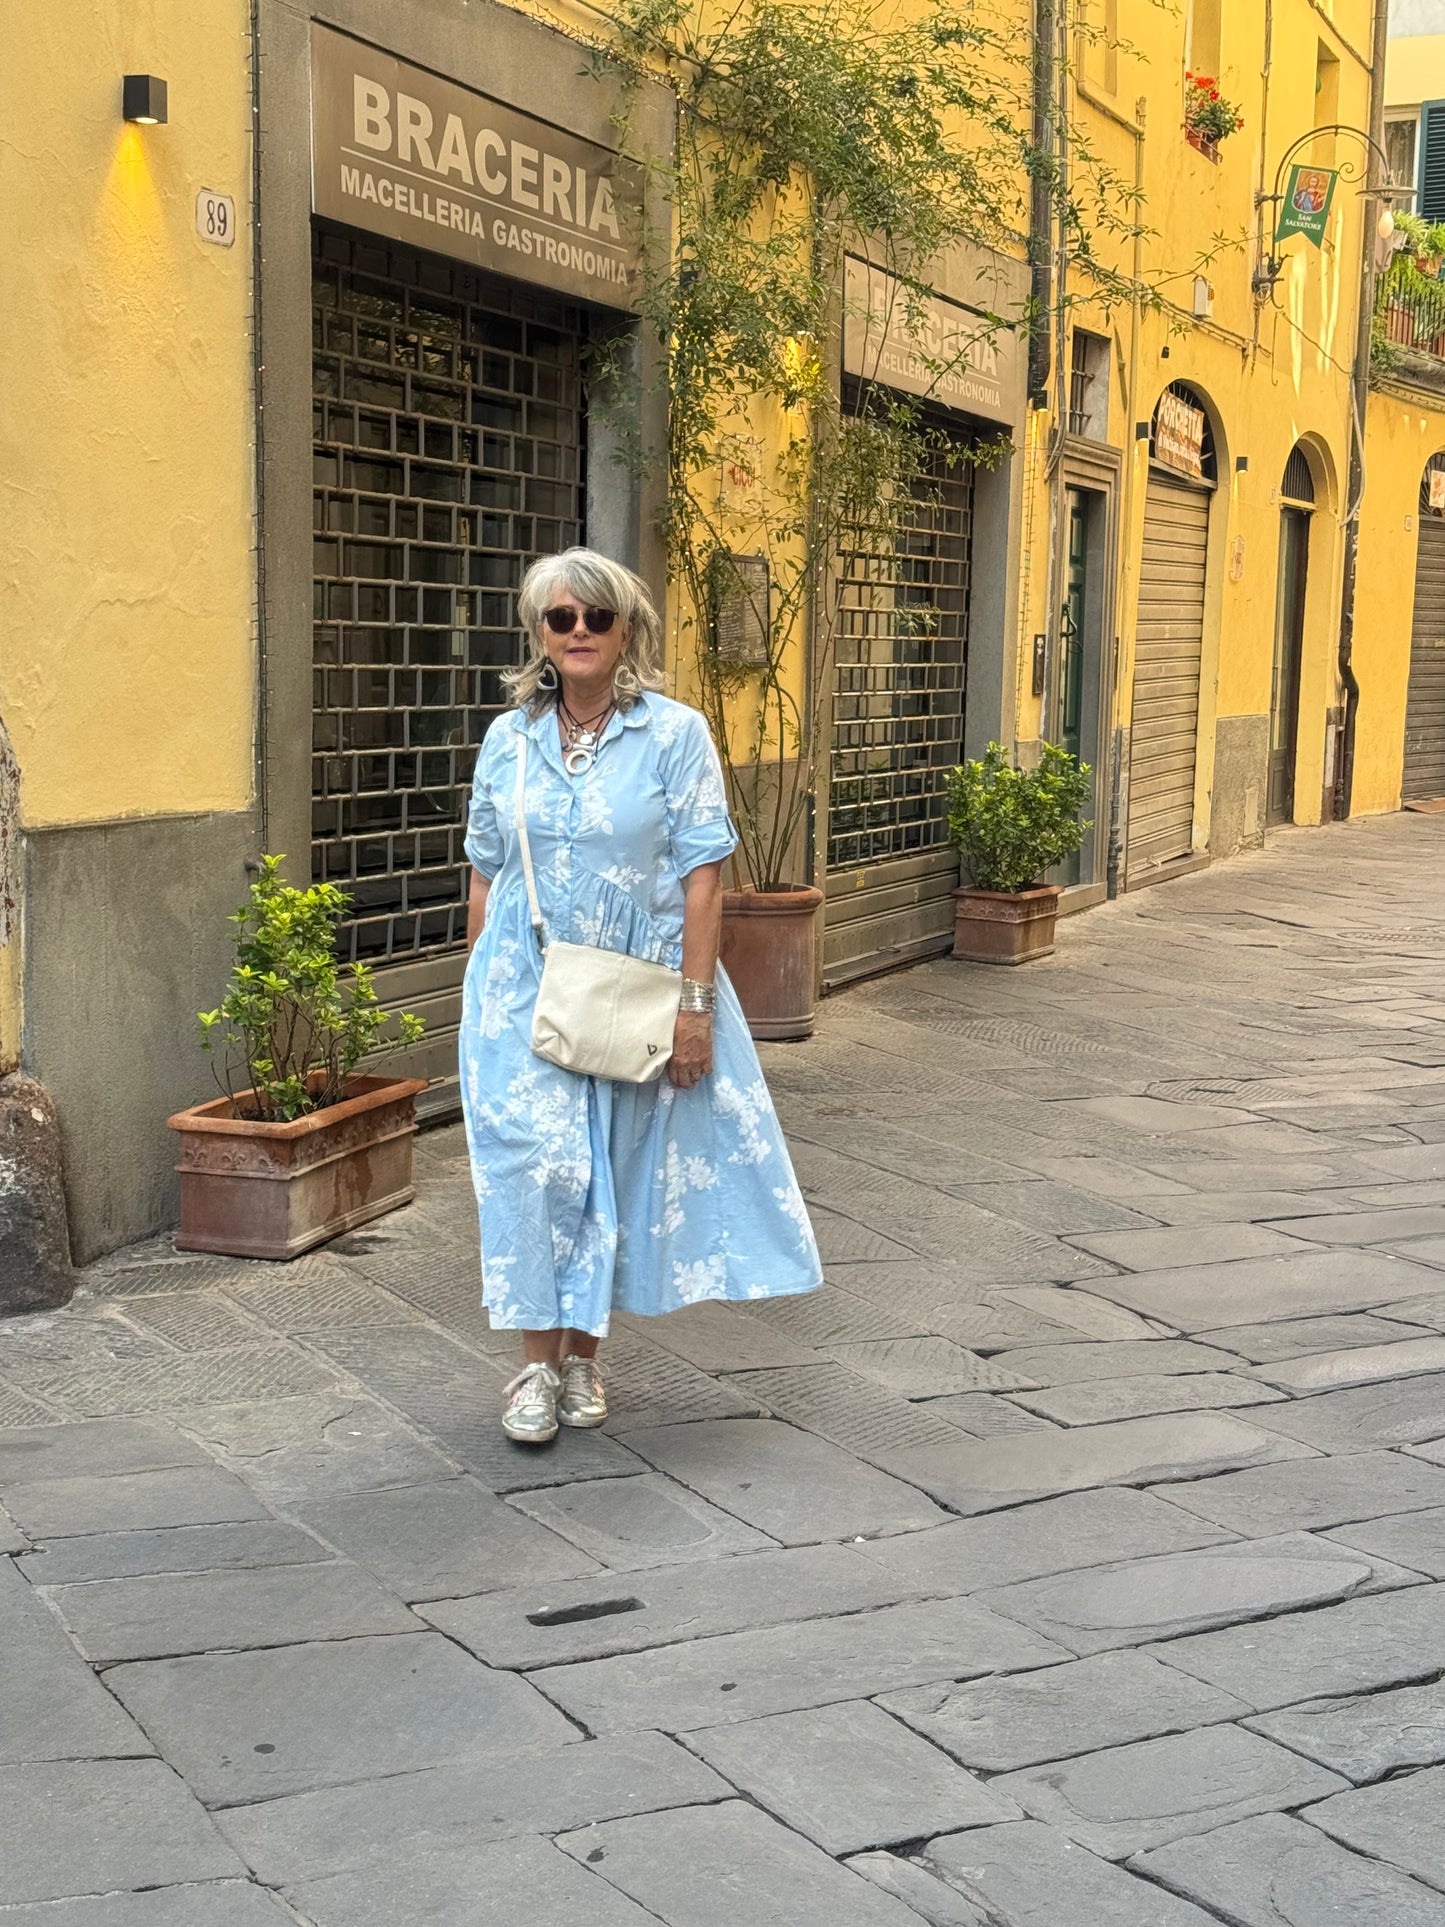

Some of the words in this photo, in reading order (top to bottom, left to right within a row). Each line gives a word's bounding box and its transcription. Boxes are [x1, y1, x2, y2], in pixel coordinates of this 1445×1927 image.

[353, 74, 620, 239] BRACERIA
[207, 200, 227, 236] 89
[340, 165, 485, 239] MACELLERIA
[492, 219, 628, 286] GASTRONOMIA
[1285, 219, 1322, 230] SALVATORE
[1297, 213, 1312, 222] SAN
